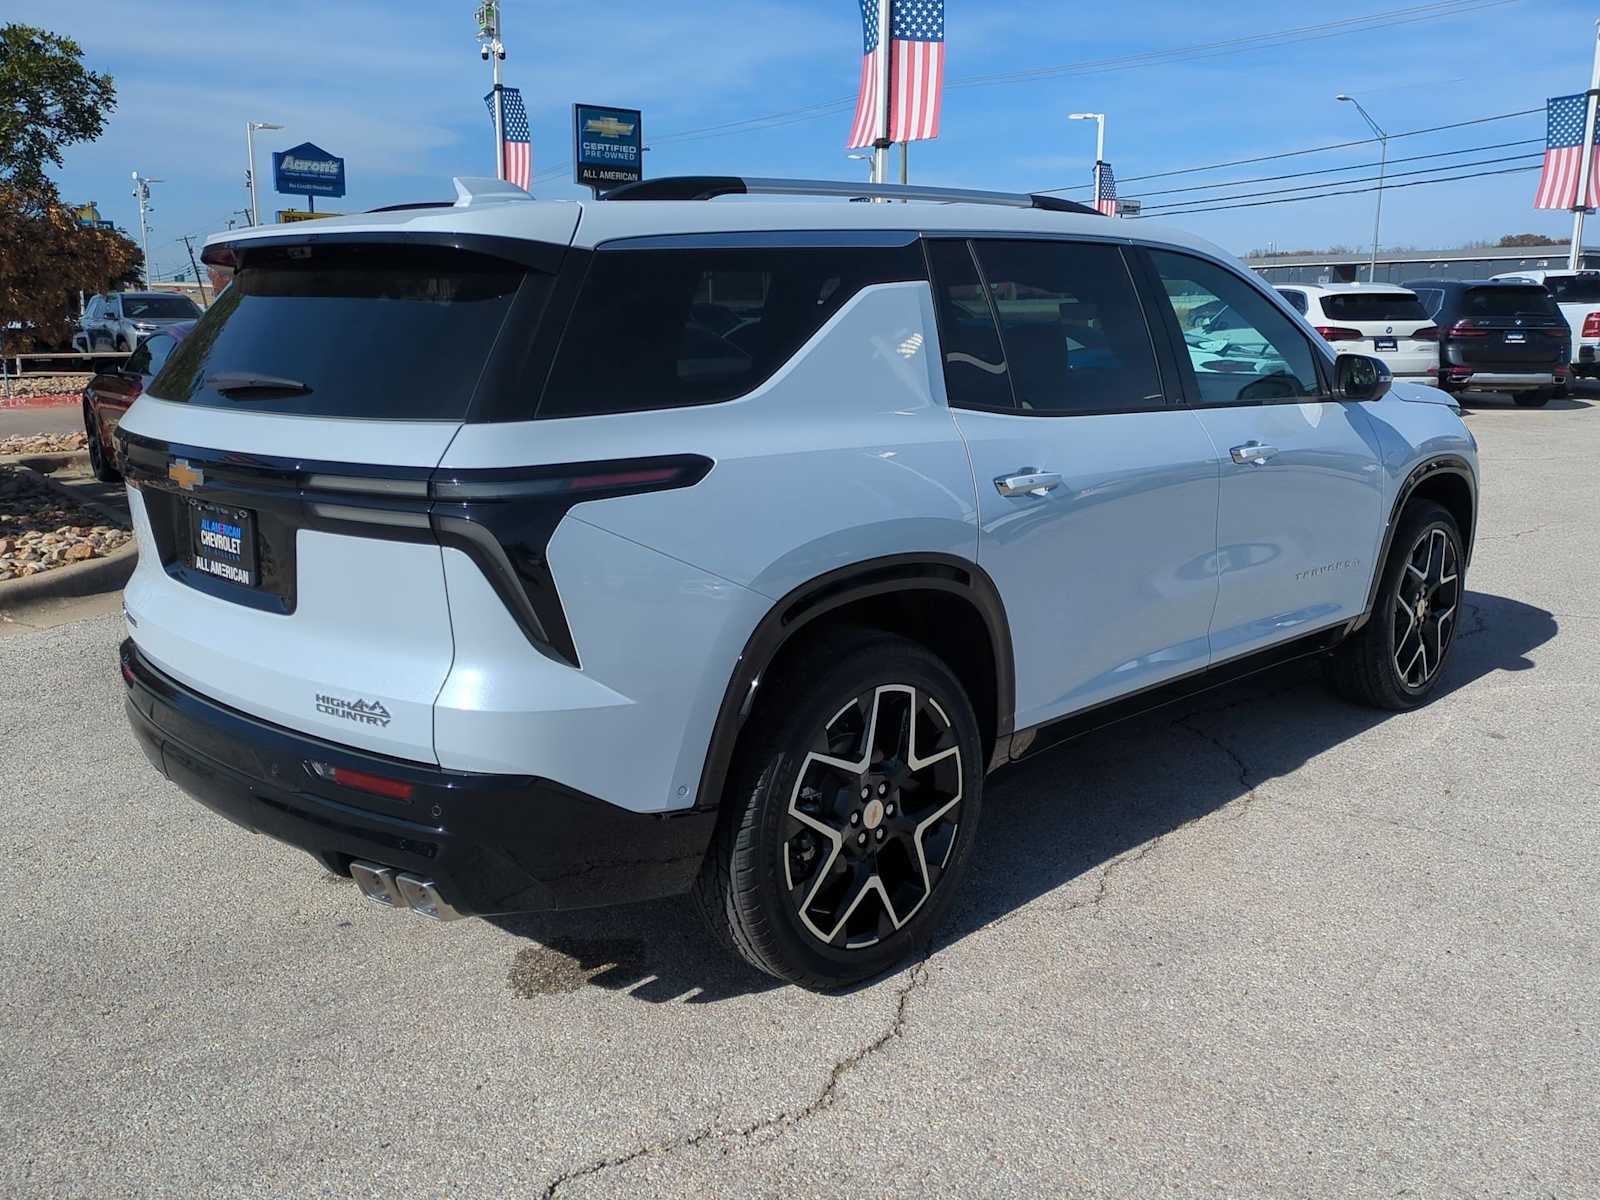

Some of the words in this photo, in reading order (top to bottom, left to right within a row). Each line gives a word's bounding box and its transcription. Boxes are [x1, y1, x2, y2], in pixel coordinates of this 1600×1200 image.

[583, 142, 637, 153] CERTIFIED
[585, 150, 635, 160] PRE-OWNED
[281, 156, 339, 173] Aaron's
[583, 169, 597, 178] ALL
[600, 170, 638, 181] AMERICAN
[201, 530, 240, 554] CHEVROLET
[196, 556, 210, 572] ALL
[210, 560, 249, 585] AMERICAN
[315, 694, 352, 709] HIGH
[316, 703, 391, 728] COUNTRY
